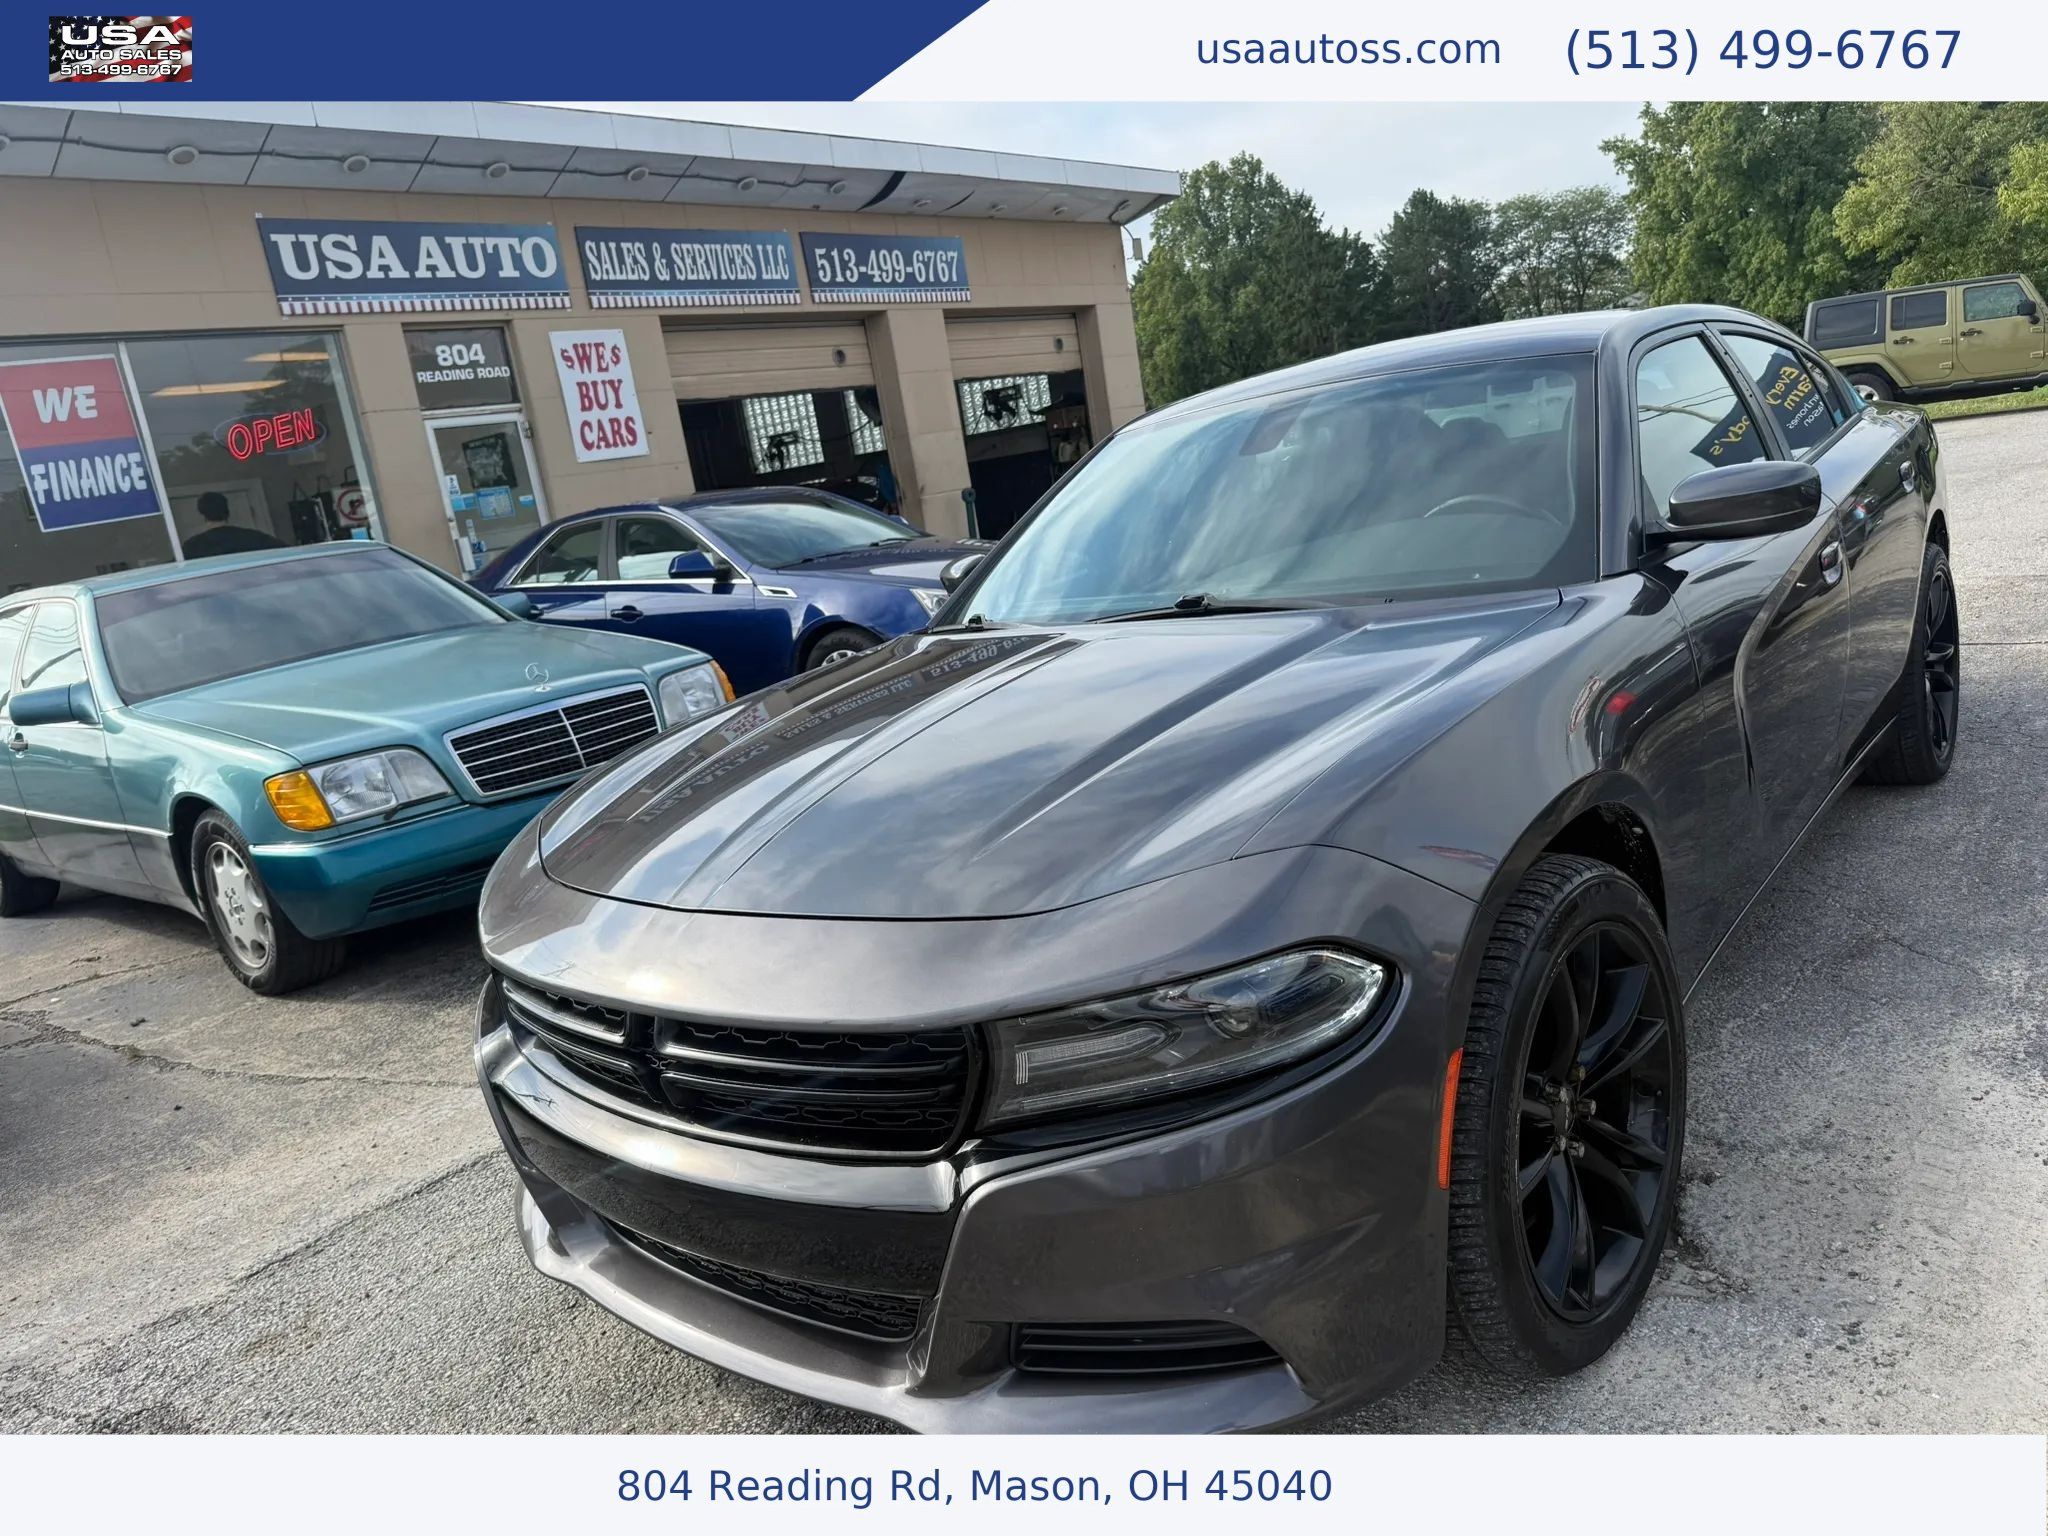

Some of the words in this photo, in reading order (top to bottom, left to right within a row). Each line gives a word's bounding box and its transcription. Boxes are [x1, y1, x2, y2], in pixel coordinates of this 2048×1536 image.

[269, 233, 410, 280] USA
[414, 236, 558, 279] AUTO
[585, 240, 651, 282] SALES
[653, 242, 671, 281] &
[671, 242, 757, 282] SERVICES
[757, 244, 790, 281] LLC
[814, 247, 959, 284] 513-499-6767
[434, 342, 486, 367] 804
[416, 369, 475, 384] READING
[477, 366, 511, 380] ROAD
[32, 384, 99, 424] WE
[575, 378, 624, 413] BUY
[227, 408, 317, 461] OPEN
[579, 415, 639, 452] CARS
[29, 452, 148, 506] FINANCE
